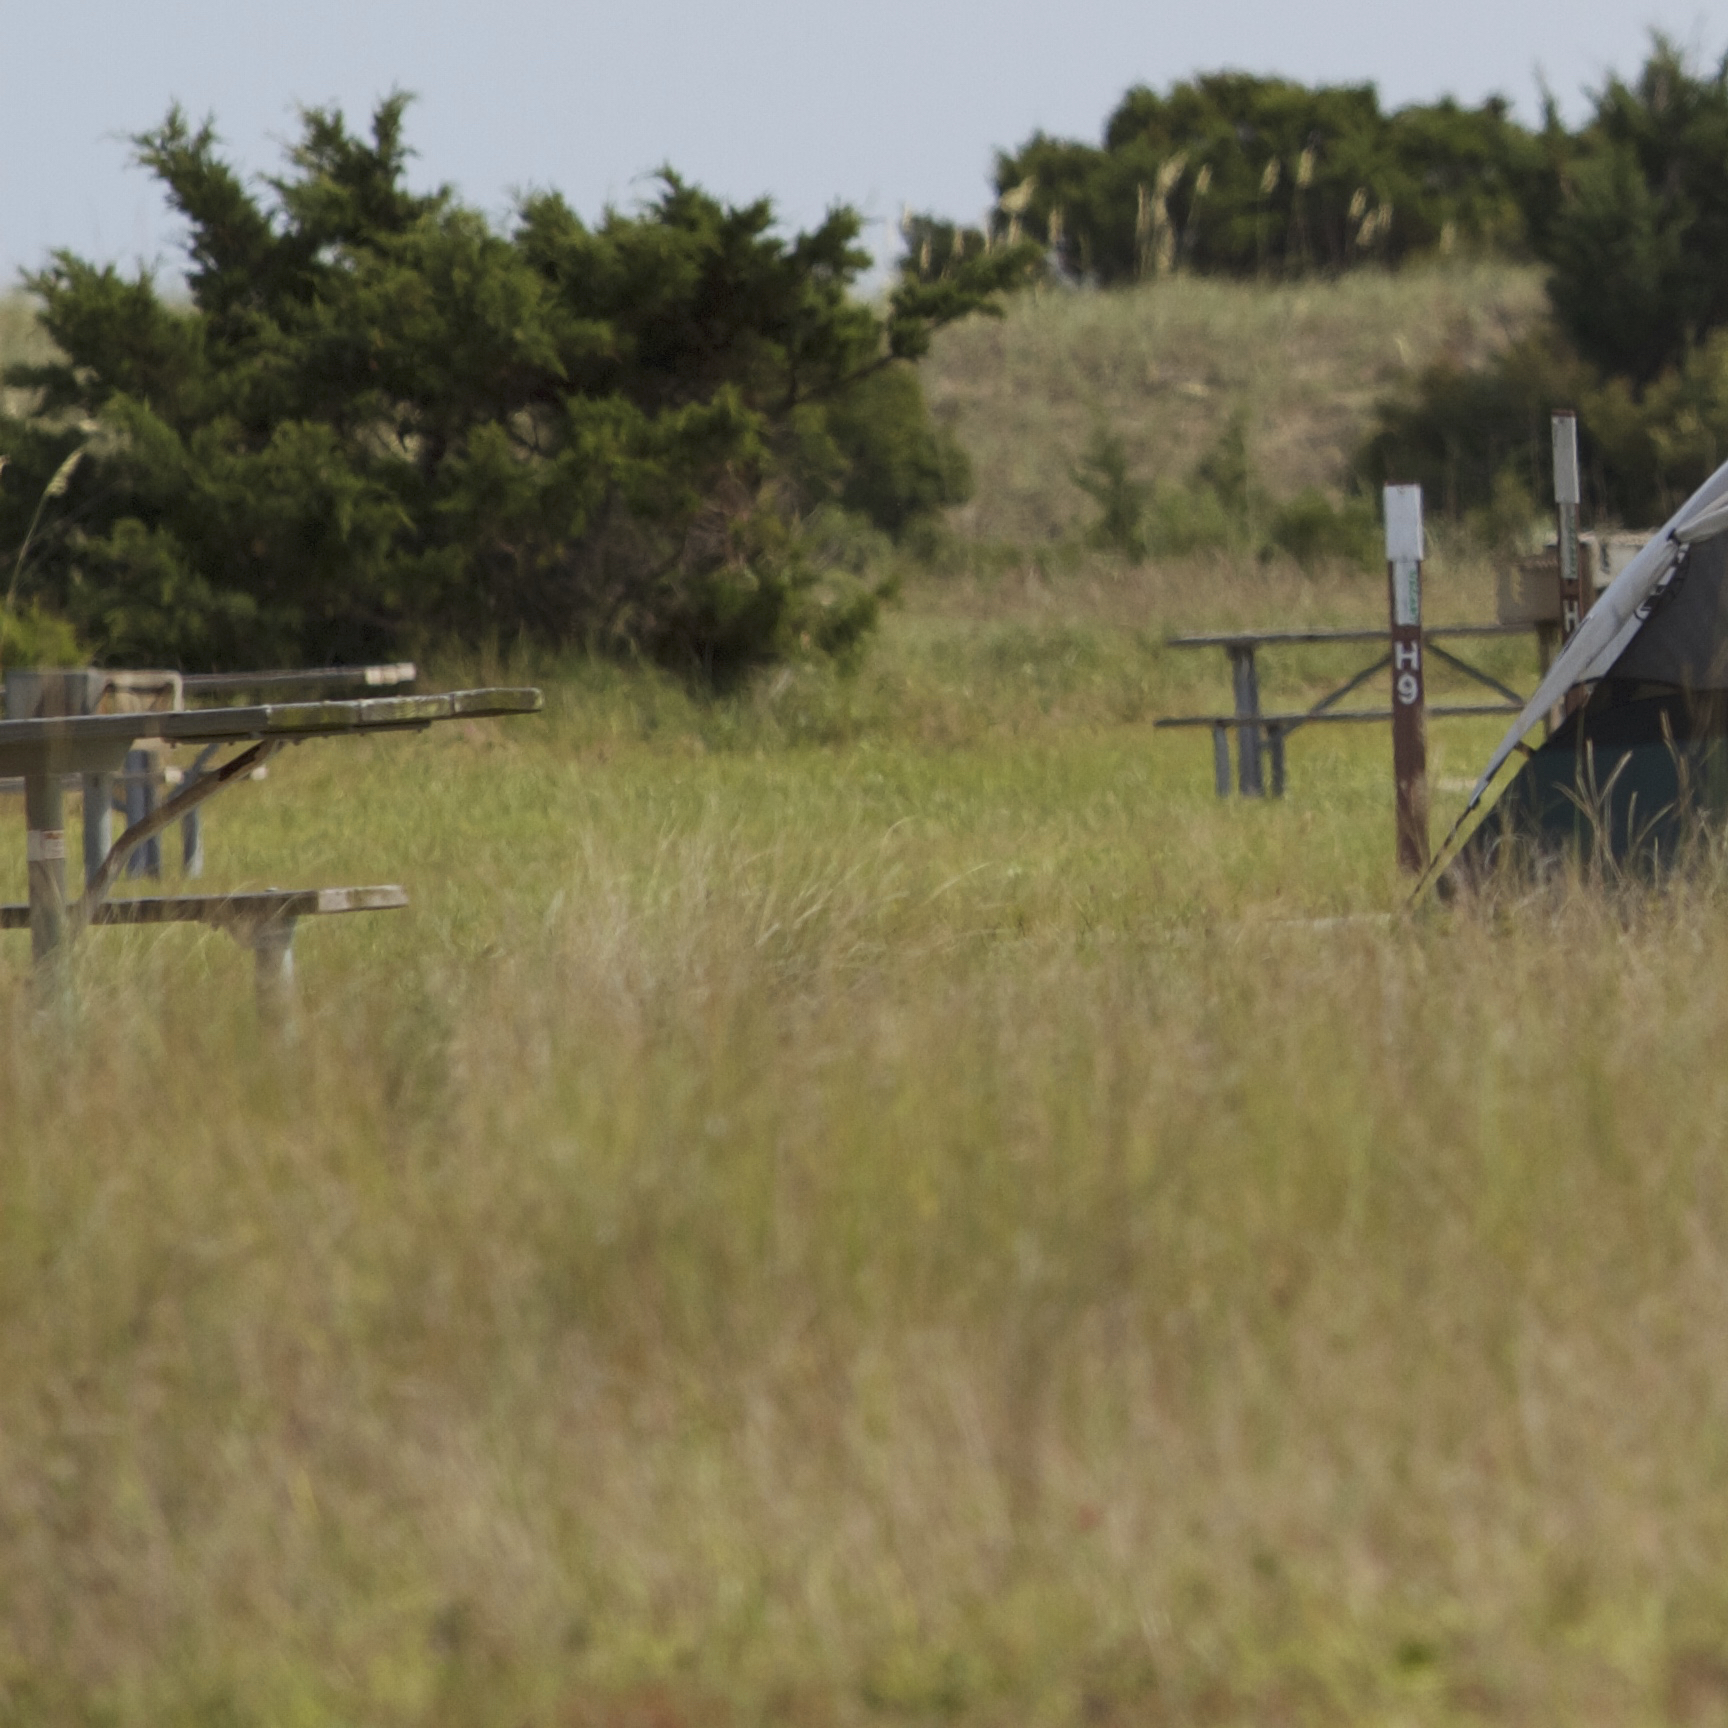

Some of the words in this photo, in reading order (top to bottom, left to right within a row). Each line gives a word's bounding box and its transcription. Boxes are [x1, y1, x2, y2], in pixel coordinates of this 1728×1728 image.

[1564, 599, 1581, 633] H
[1395, 640, 1419, 670] H
[1397, 672, 1419, 705] 9
